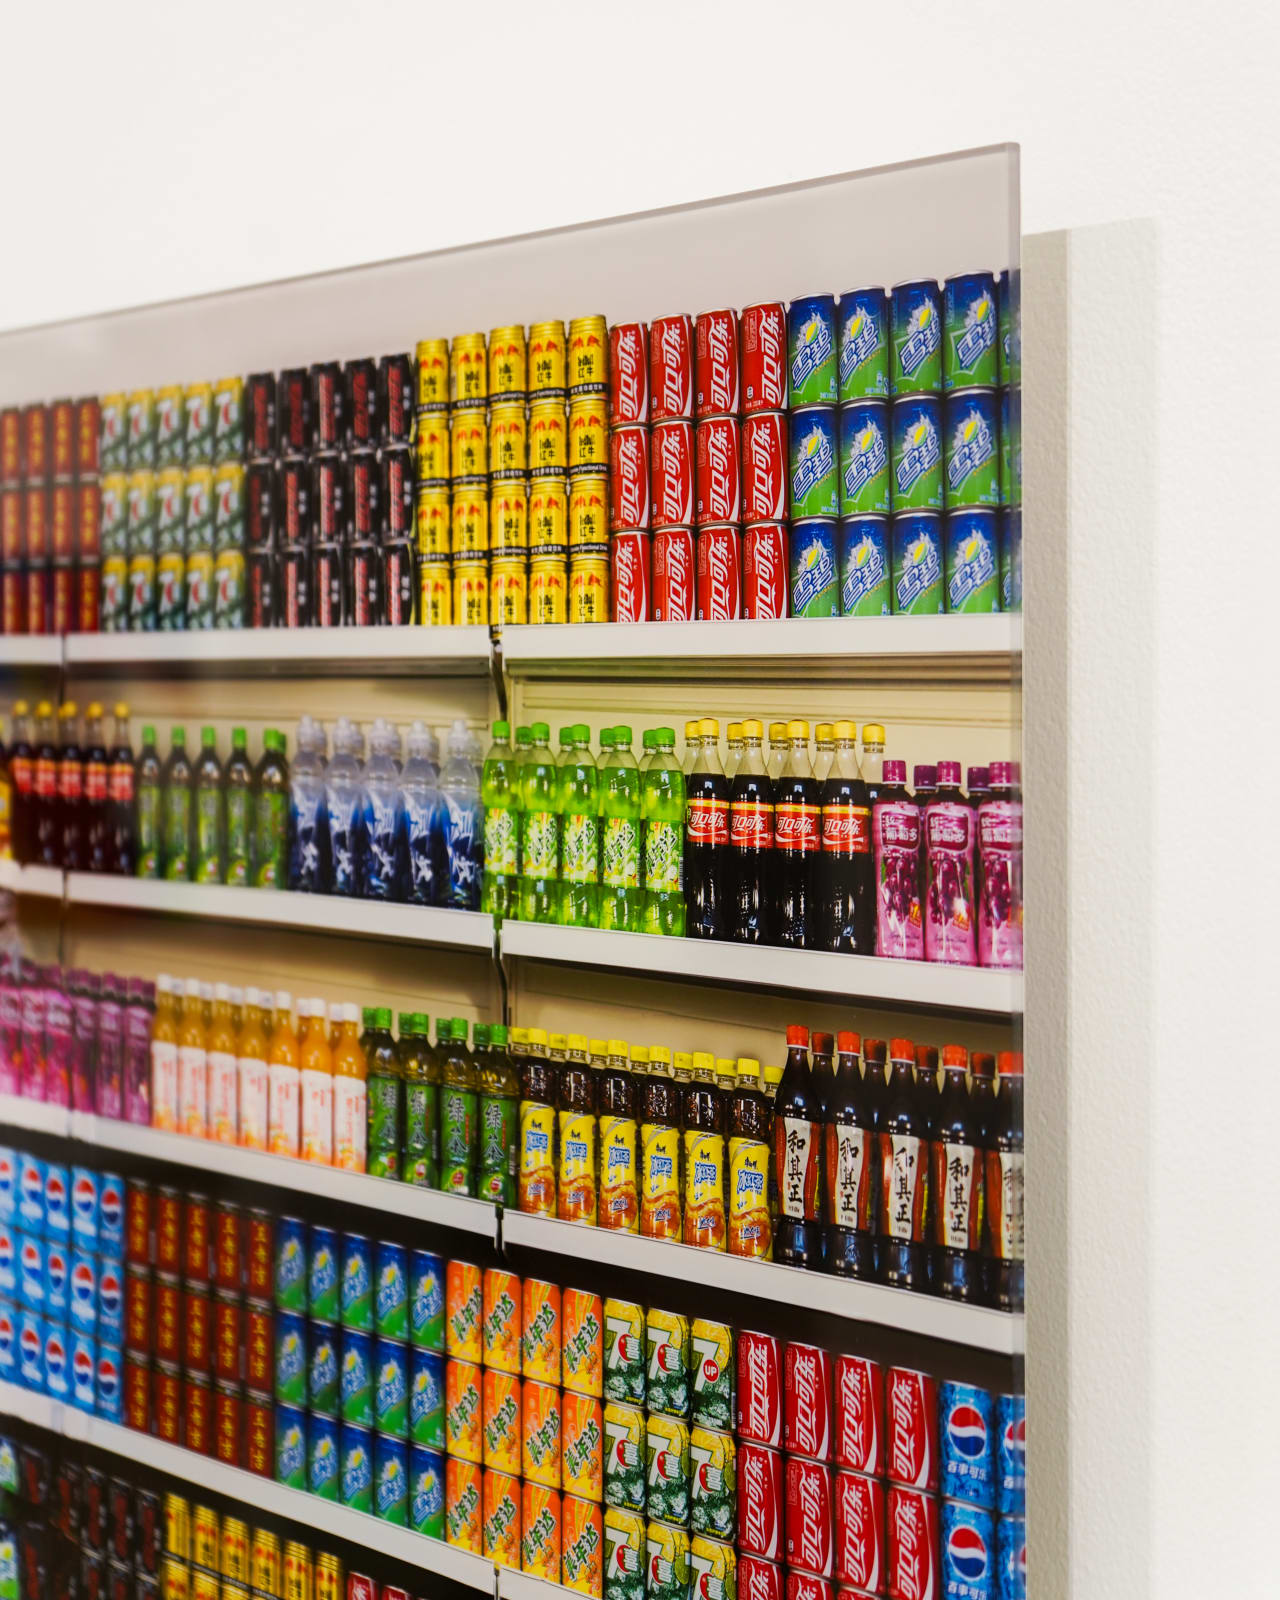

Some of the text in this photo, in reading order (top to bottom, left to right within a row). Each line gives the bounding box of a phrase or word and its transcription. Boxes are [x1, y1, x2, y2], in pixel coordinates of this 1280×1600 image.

[617, 329, 638, 419] 可口可乐
[661, 321, 683, 414] 可口可乐
[708, 315, 730, 409] 可口可乐
[759, 307, 781, 405] 可口可乐
[619, 432, 640, 523] 可口可乐
[661, 428, 683, 521] 可口可乐
[708, 424, 730, 517] 可口可乐
[751, 420, 773, 516] 可口可乐
[691, 811, 726, 827] 可口可乐
[732, 814, 765, 831] 可口可乐
[777, 816, 815, 834] 可口可乐
[825, 819, 862, 835] 可口可乐
[448, 1095, 469, 1156] 绿茶
[484, 1103, 505, 1163] 绿茶
[787, 1130, 806, 1203] 和其正
[840, 1137, 859, 1213] 和其正
[895, 1147, 914, 1224] 和其正
[949, 1157, 969, 1233] 和其正
[748, 1336, 770, 1440] 可口可乐
[794, 1349, 817, 1452] 可口可乐
[841, 1360, 864, 1466] 可口可乐
[892, 1372, 916, 1479] 可口可乐
[744, 1449, 766, 1550] 可口可乐
[799, 1465, 823, 1570] 可口可乐
[842, 1478, 866, 1584] 可口可乐
[895, 1493, 920, 1600] 可口可乐
